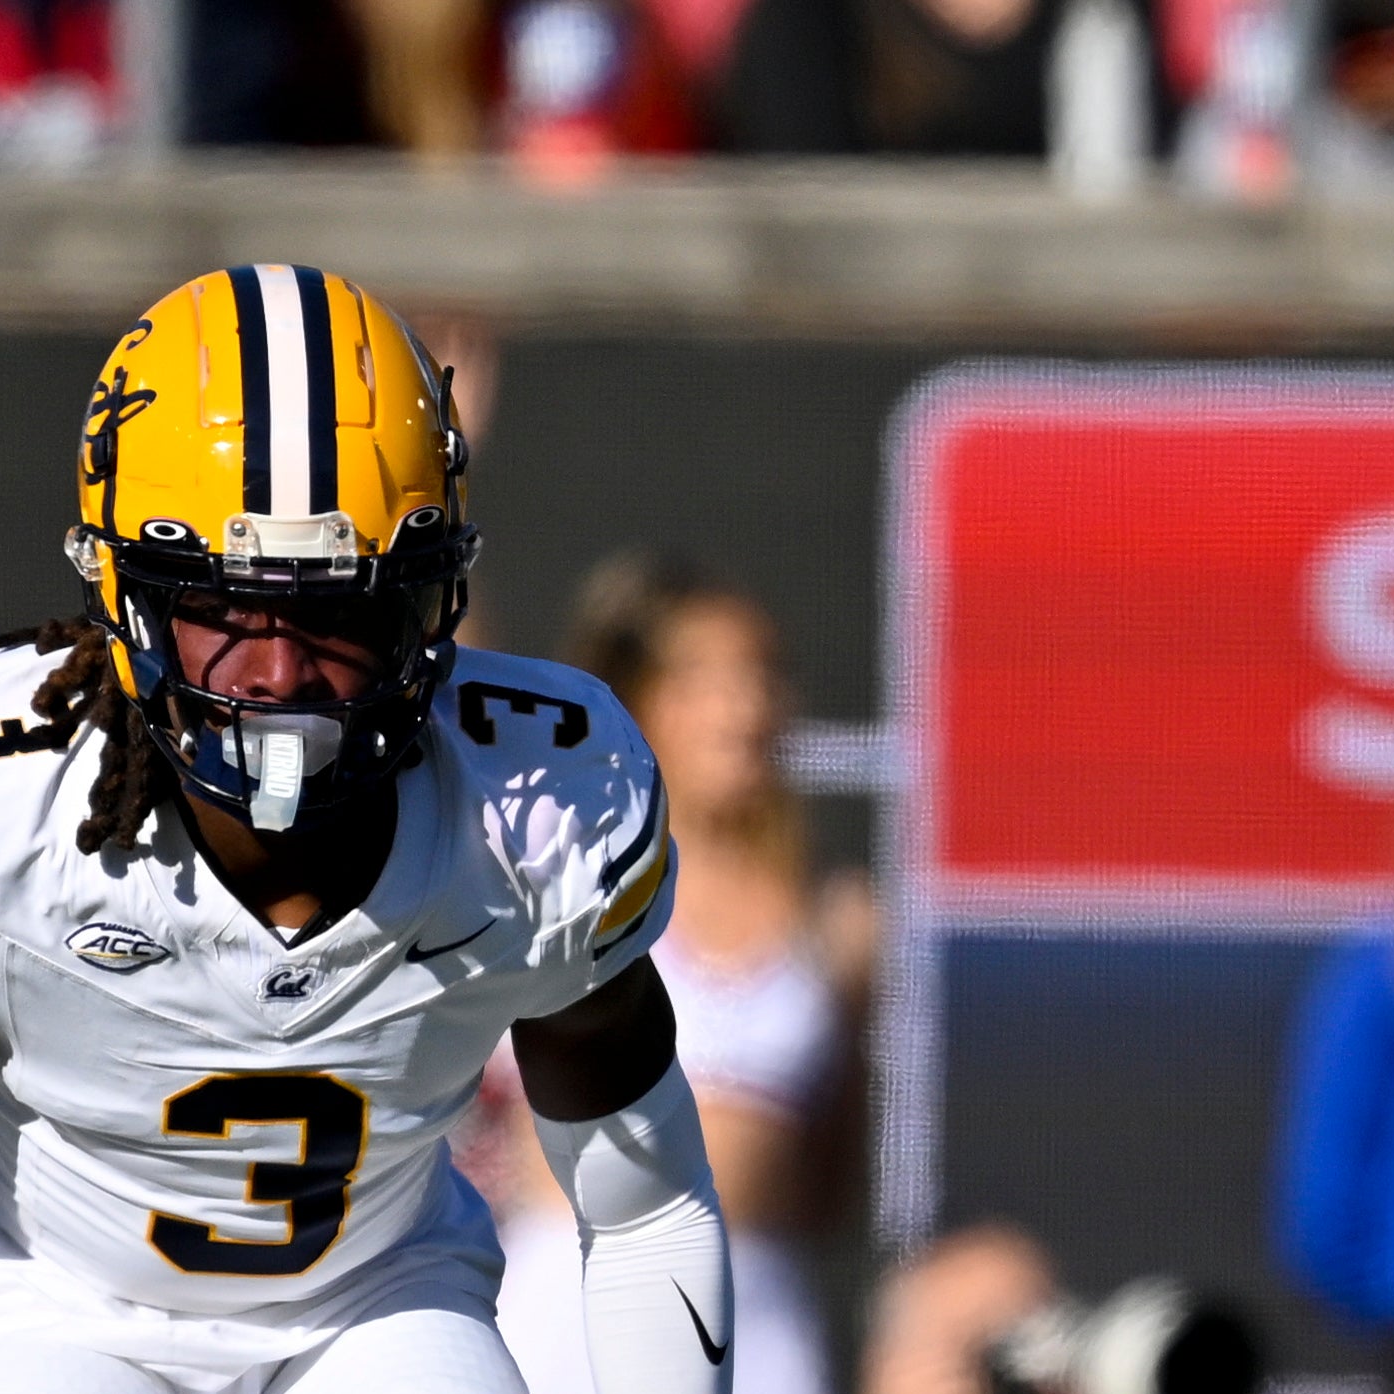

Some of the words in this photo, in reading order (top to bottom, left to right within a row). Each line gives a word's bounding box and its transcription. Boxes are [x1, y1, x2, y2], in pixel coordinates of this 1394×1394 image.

[457, 678, 590, 749] 3
[81, 936, 152, 956] ACC
[263, 968, 313, 1000] Cal
[147, 1071, 369, 1276] 3
